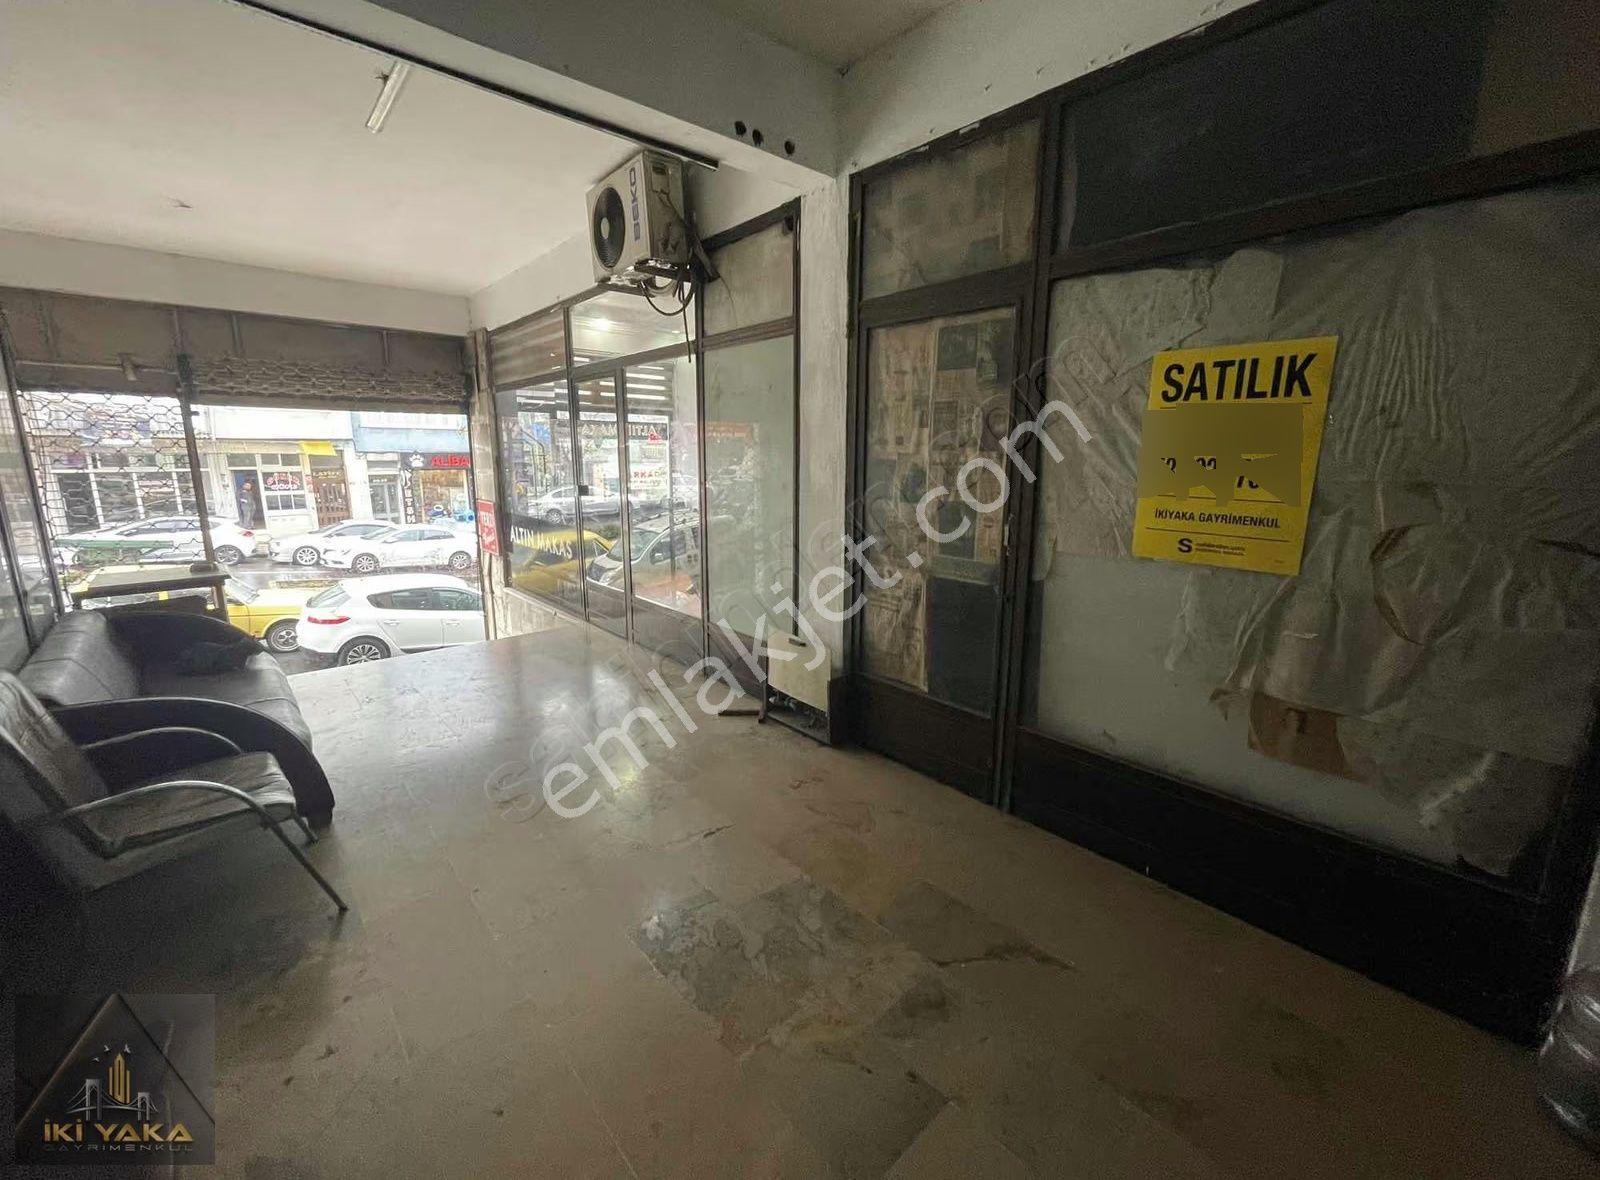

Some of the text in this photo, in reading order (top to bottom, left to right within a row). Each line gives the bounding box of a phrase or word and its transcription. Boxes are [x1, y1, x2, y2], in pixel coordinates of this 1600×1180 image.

[629, 166, 641, 242] BEKO
[1160, 352, 1318, 403] SATILIK
[1155, 507, 1281, 529] İKİYAKA GAYRİMENKUL
[510, 525, 534, 547] ALTIN
[537, 531, 573, 560] MAKAS
